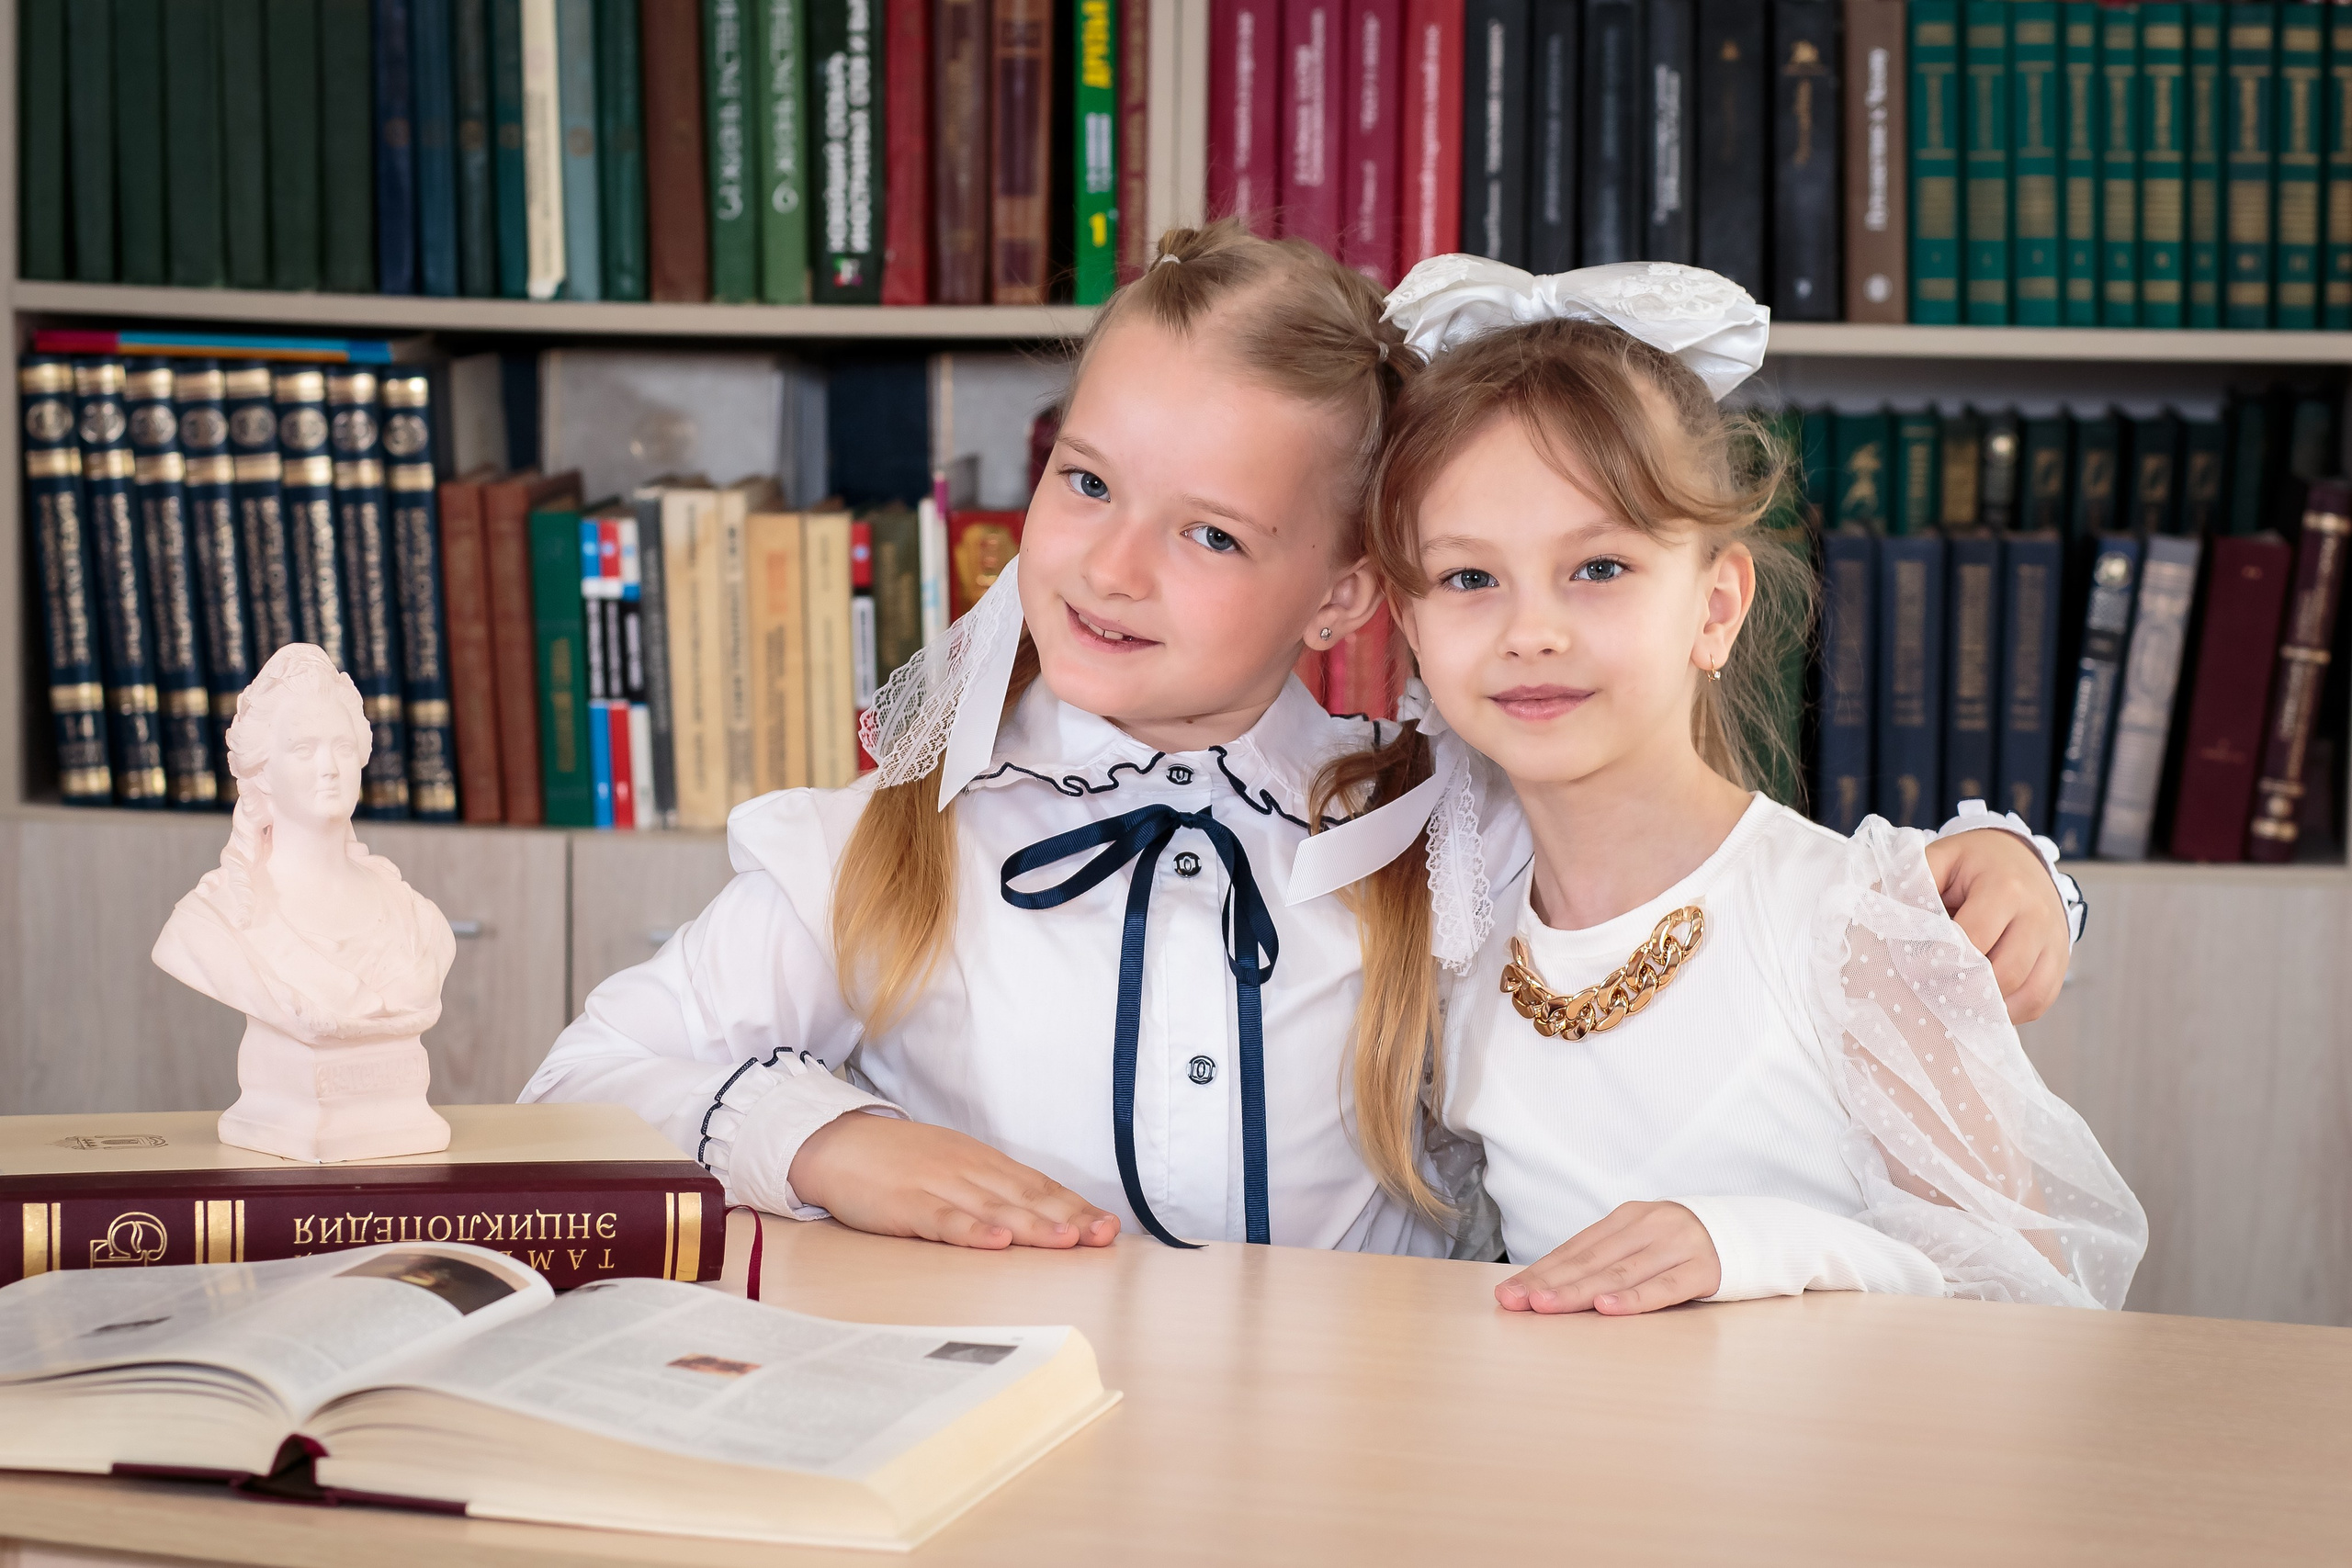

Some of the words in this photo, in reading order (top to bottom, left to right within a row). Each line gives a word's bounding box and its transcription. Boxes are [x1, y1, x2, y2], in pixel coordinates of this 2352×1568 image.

[714, 0, 742, 99] РАСТЕН
[768, 0, 796, 95] РАСТЕН
[1090, 212, 1108, 246] 1
[293, 1210, 616, 1244] ЭНЦИКЛОПЕДИЯ
